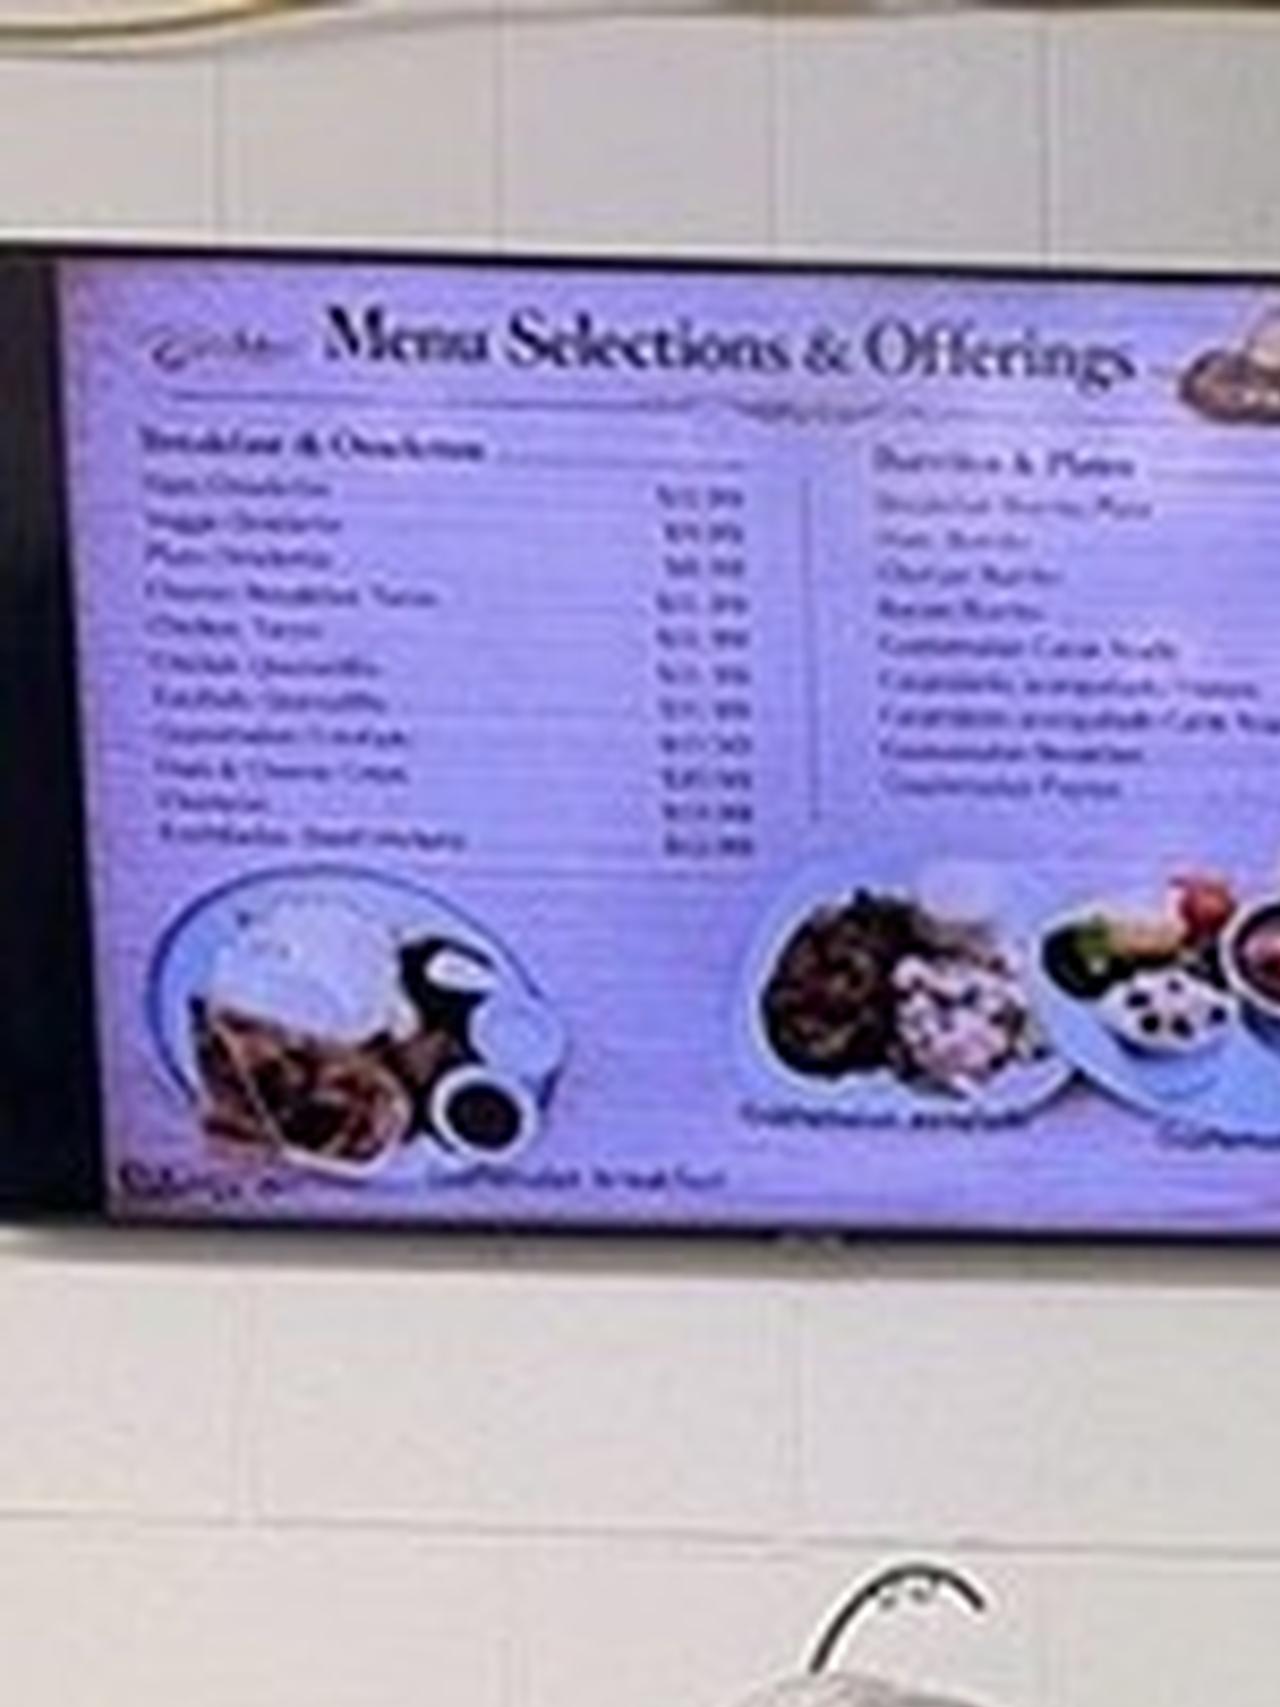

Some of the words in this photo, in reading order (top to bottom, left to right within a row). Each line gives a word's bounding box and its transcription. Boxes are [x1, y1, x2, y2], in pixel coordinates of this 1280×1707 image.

[325, 302, 491, 367] Menu
[505, 306, 797, 375] Selections
[801, 326, 852, 376] &
[864, 319, 1138, 392] Offerings
